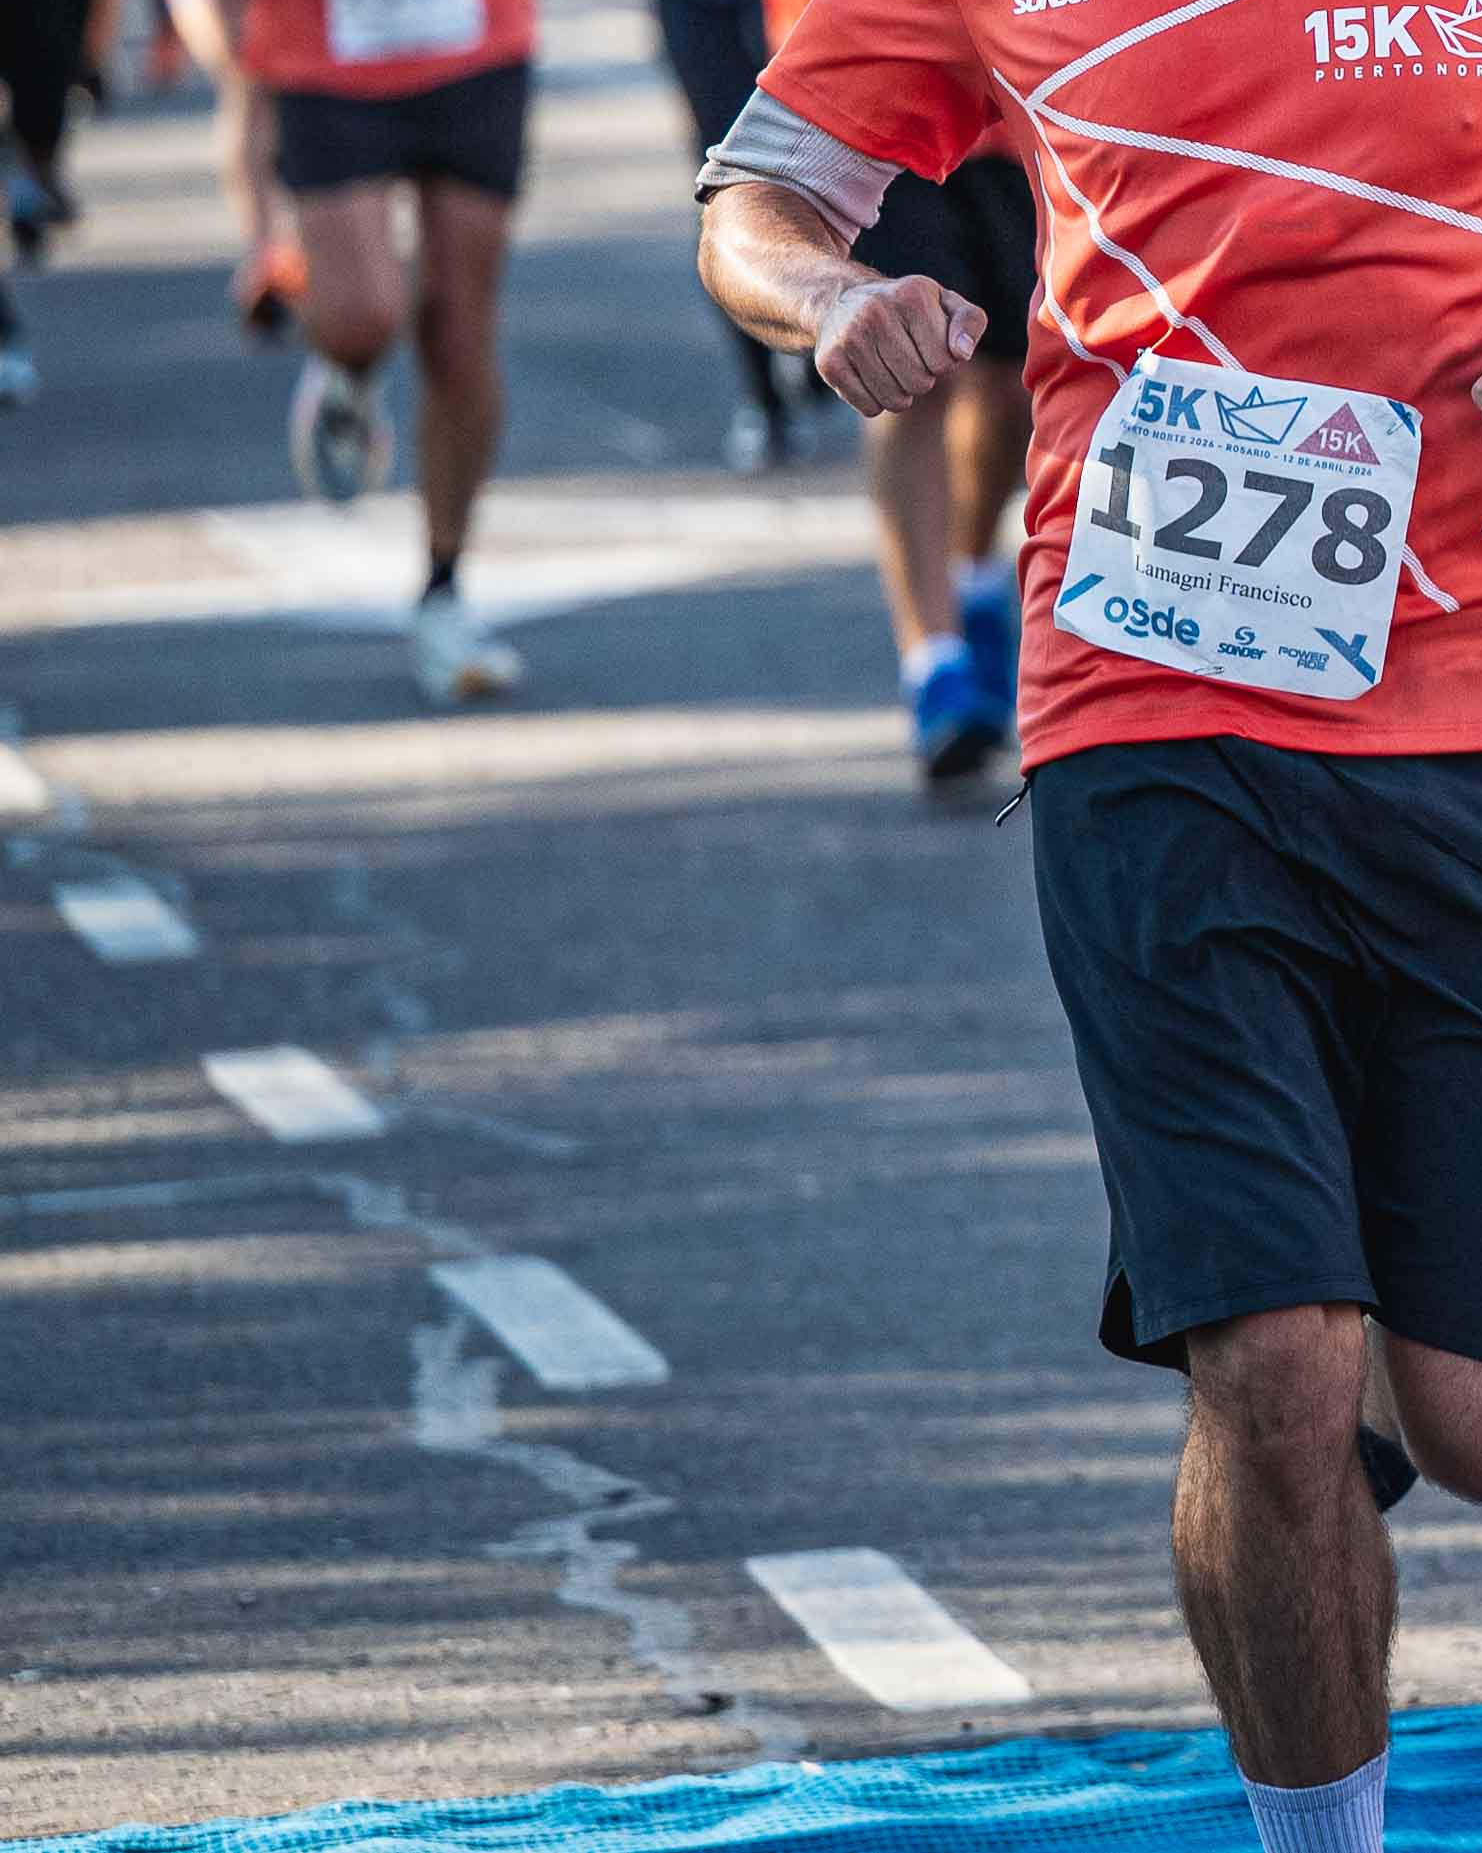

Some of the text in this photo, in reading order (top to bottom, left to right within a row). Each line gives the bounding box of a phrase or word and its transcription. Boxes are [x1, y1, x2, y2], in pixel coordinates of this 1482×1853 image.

[1304, 5, 1423, 64] 15K
[1315, 63, 1414, 83] PUERTO
[1152, 429, 1187, 443] NORTE
[1190, 437, 1215, 448] 2026
[1225, 443, 1271, 460] ROSARIO
[1314, 461, 1345, 474] ABRIL
[1317, 428, 1363, 455] 15K
[1090, 442, 1393, 585] 1278
[1135, 555, 1313, 609] Lamagni Francisco
[1104, 596, 1200, 646] osde
